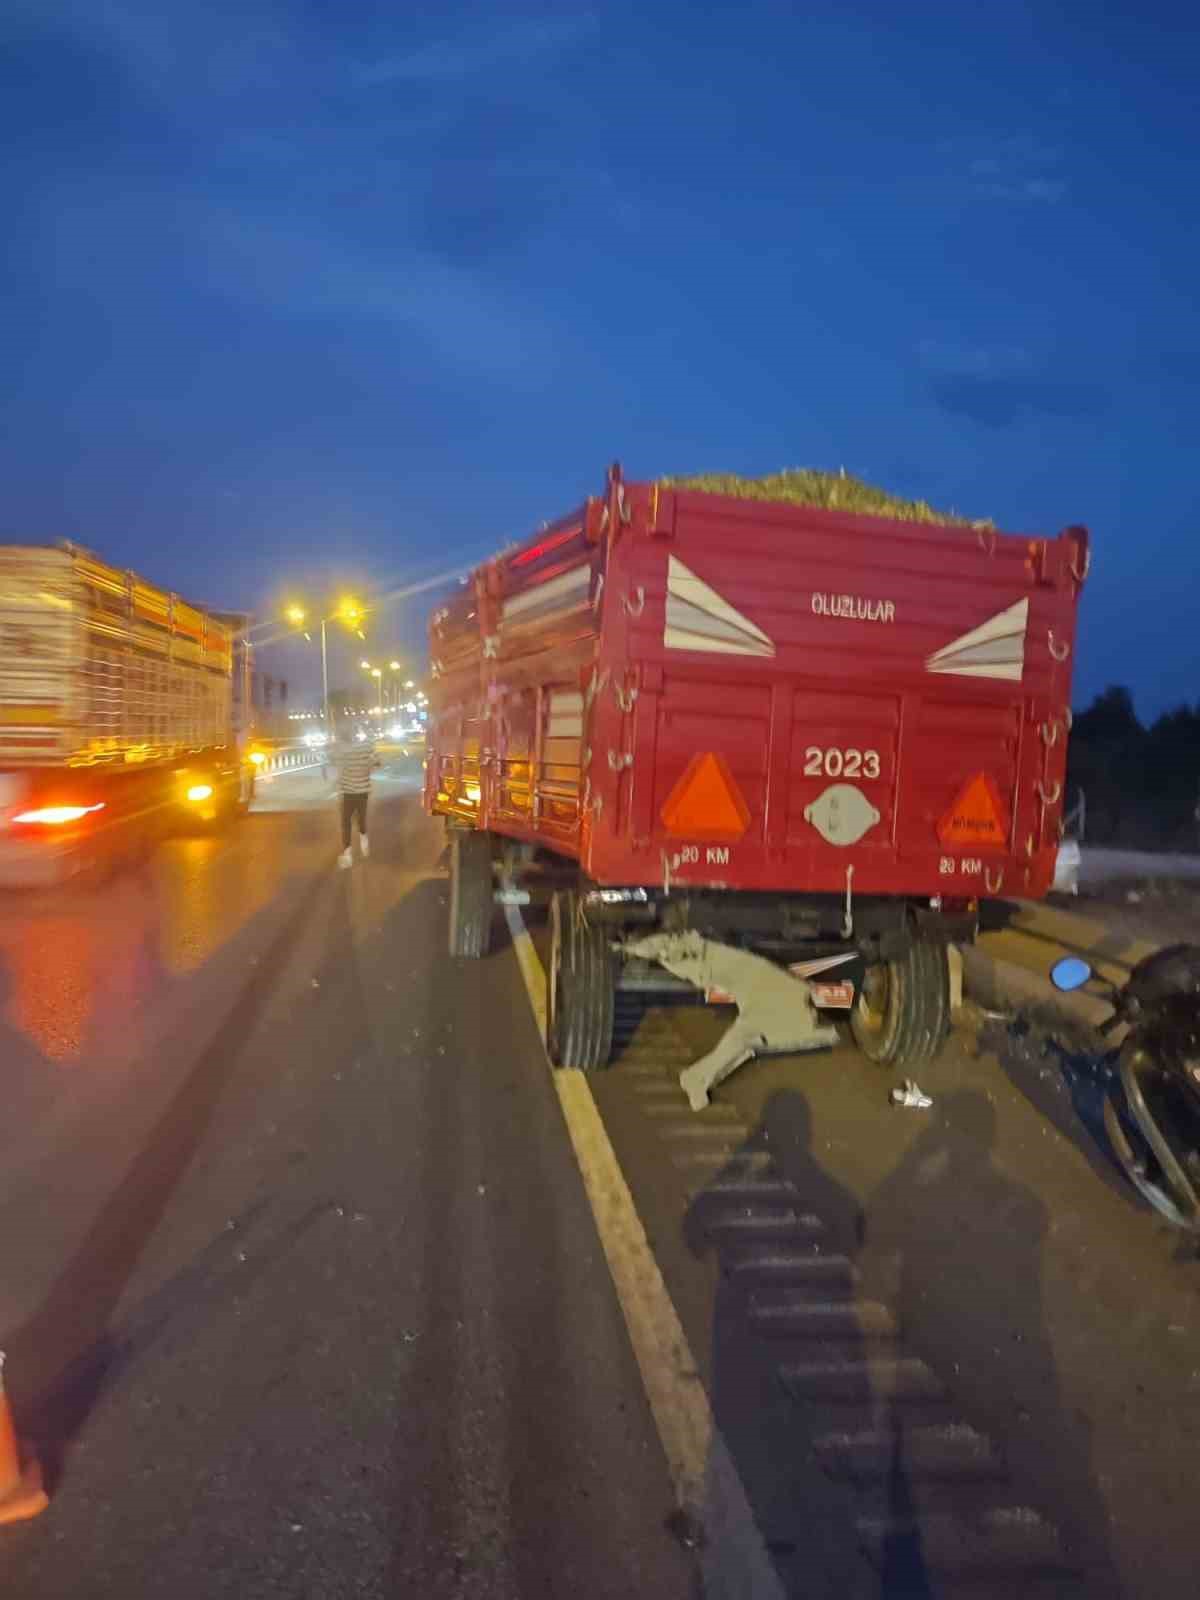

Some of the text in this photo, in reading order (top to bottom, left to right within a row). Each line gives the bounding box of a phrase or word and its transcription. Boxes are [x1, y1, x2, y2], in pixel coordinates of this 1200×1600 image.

[803, 746, 880, 778] 2023
[706, 846, 730, 865] KM
[961, 858, 982, 875] KM
